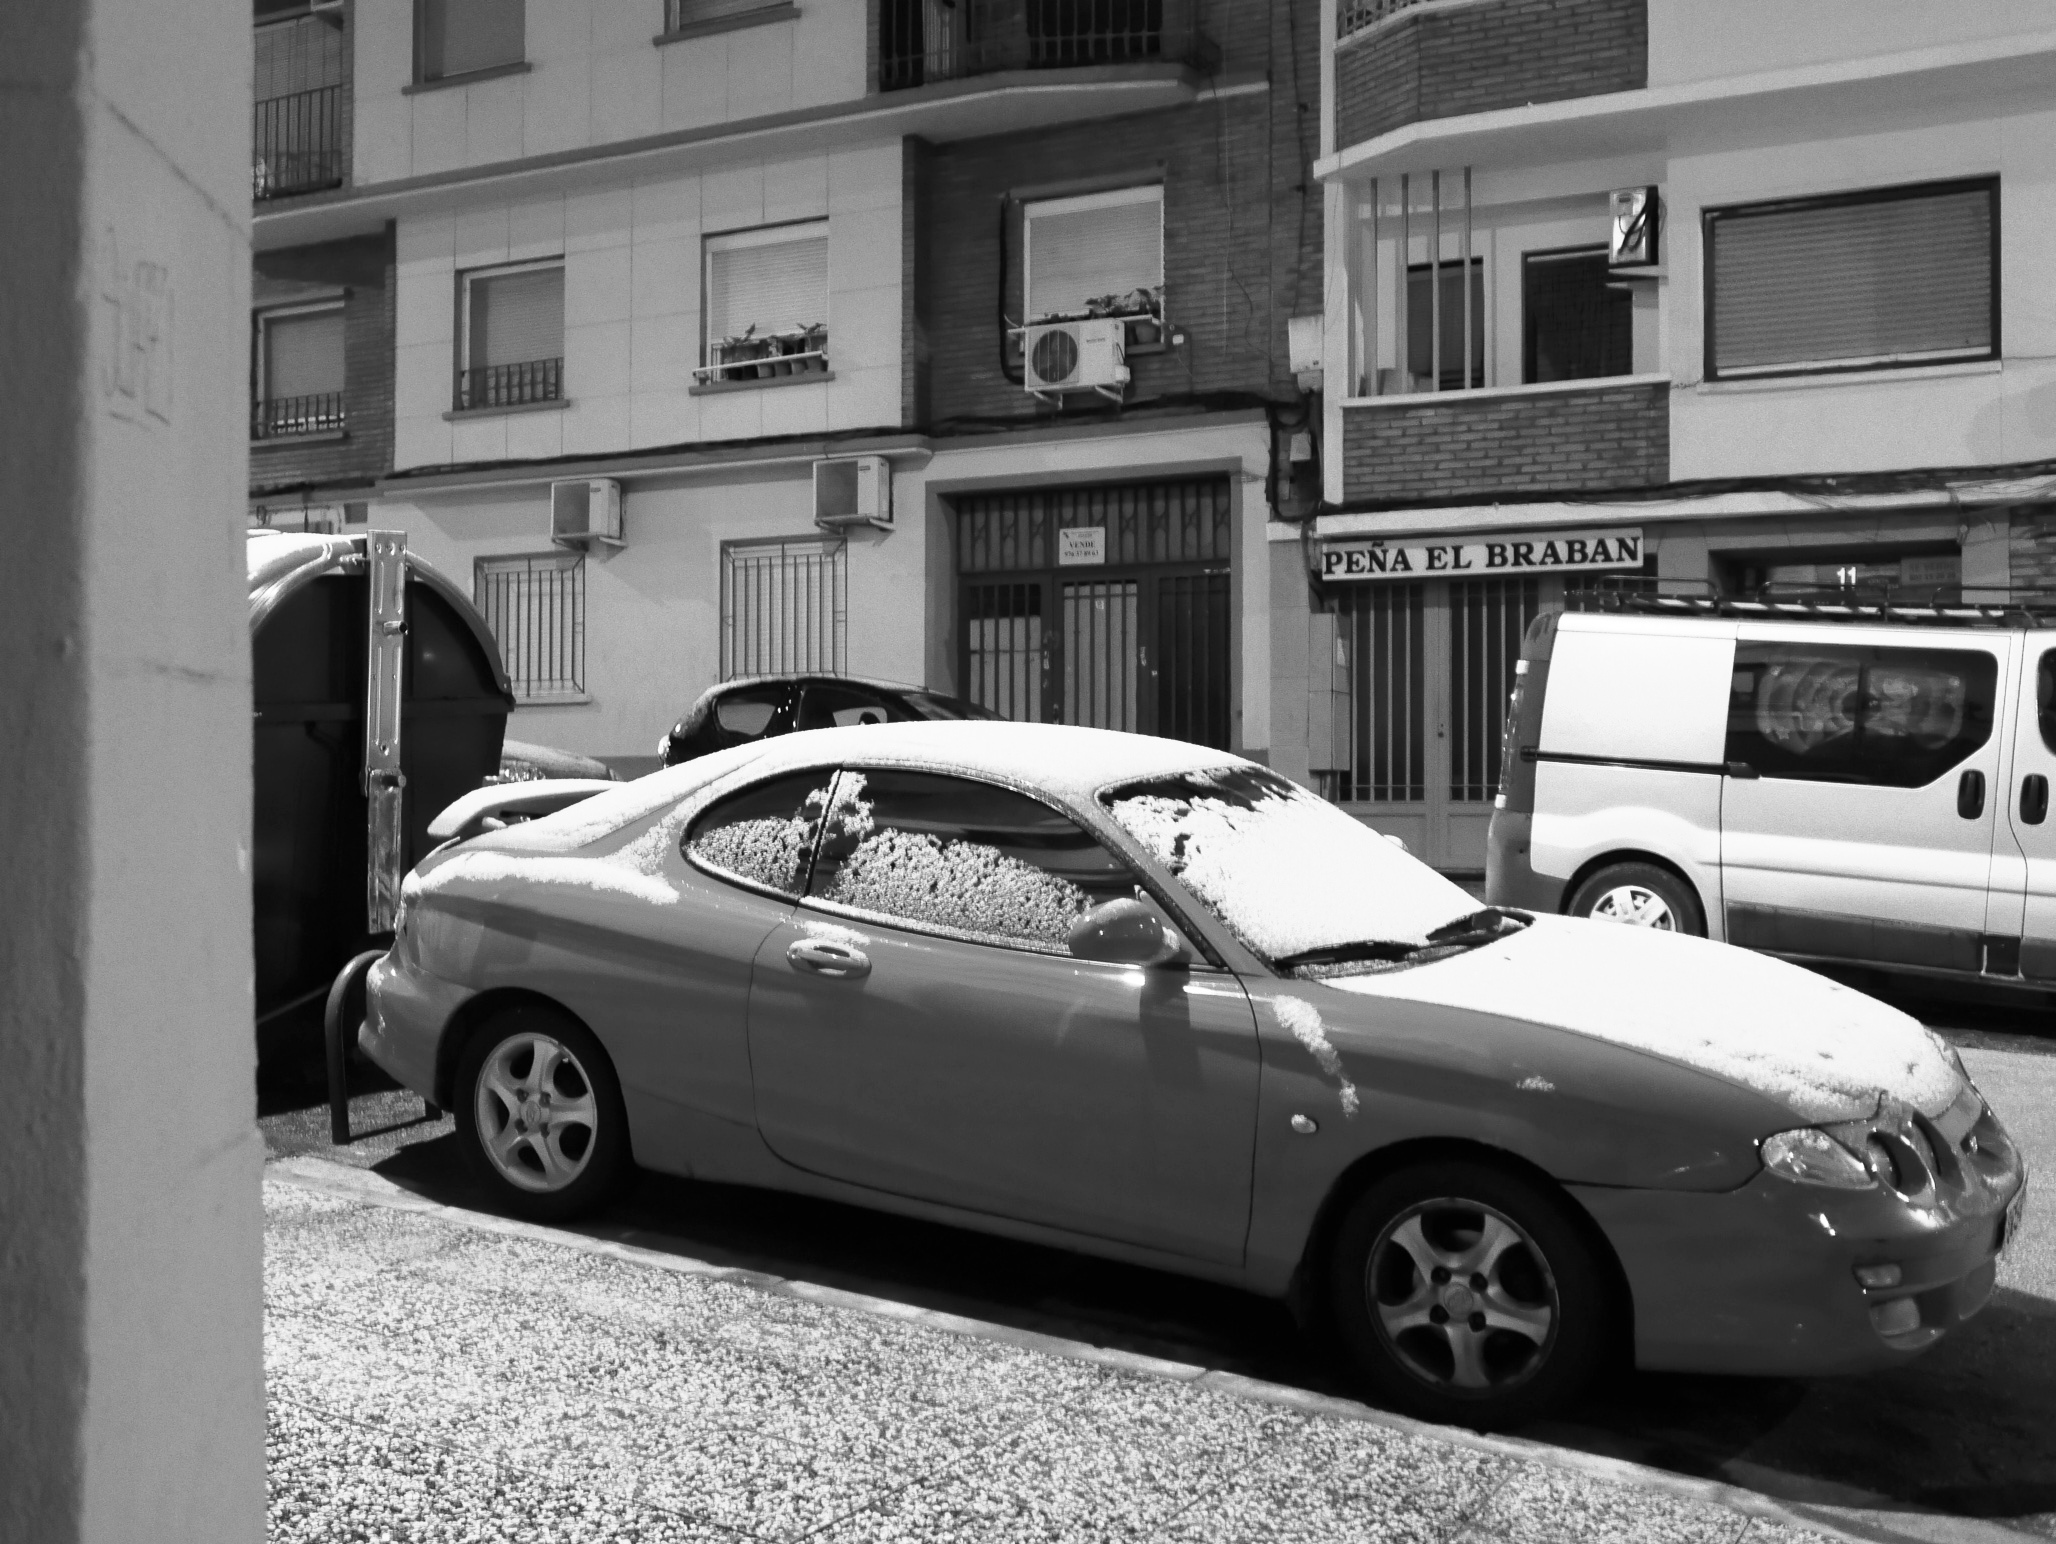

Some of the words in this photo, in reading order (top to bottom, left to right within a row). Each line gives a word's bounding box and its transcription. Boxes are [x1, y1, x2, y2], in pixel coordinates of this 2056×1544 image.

[1069, 540, 1096, 548] VENDE
[1323, 541, 1413, 575] PEÑA
[1425, 545, 1472, 570] EL
[1485, 536, 1640, 568] BRABAN
[1836, 566, 1857, 591] 11
